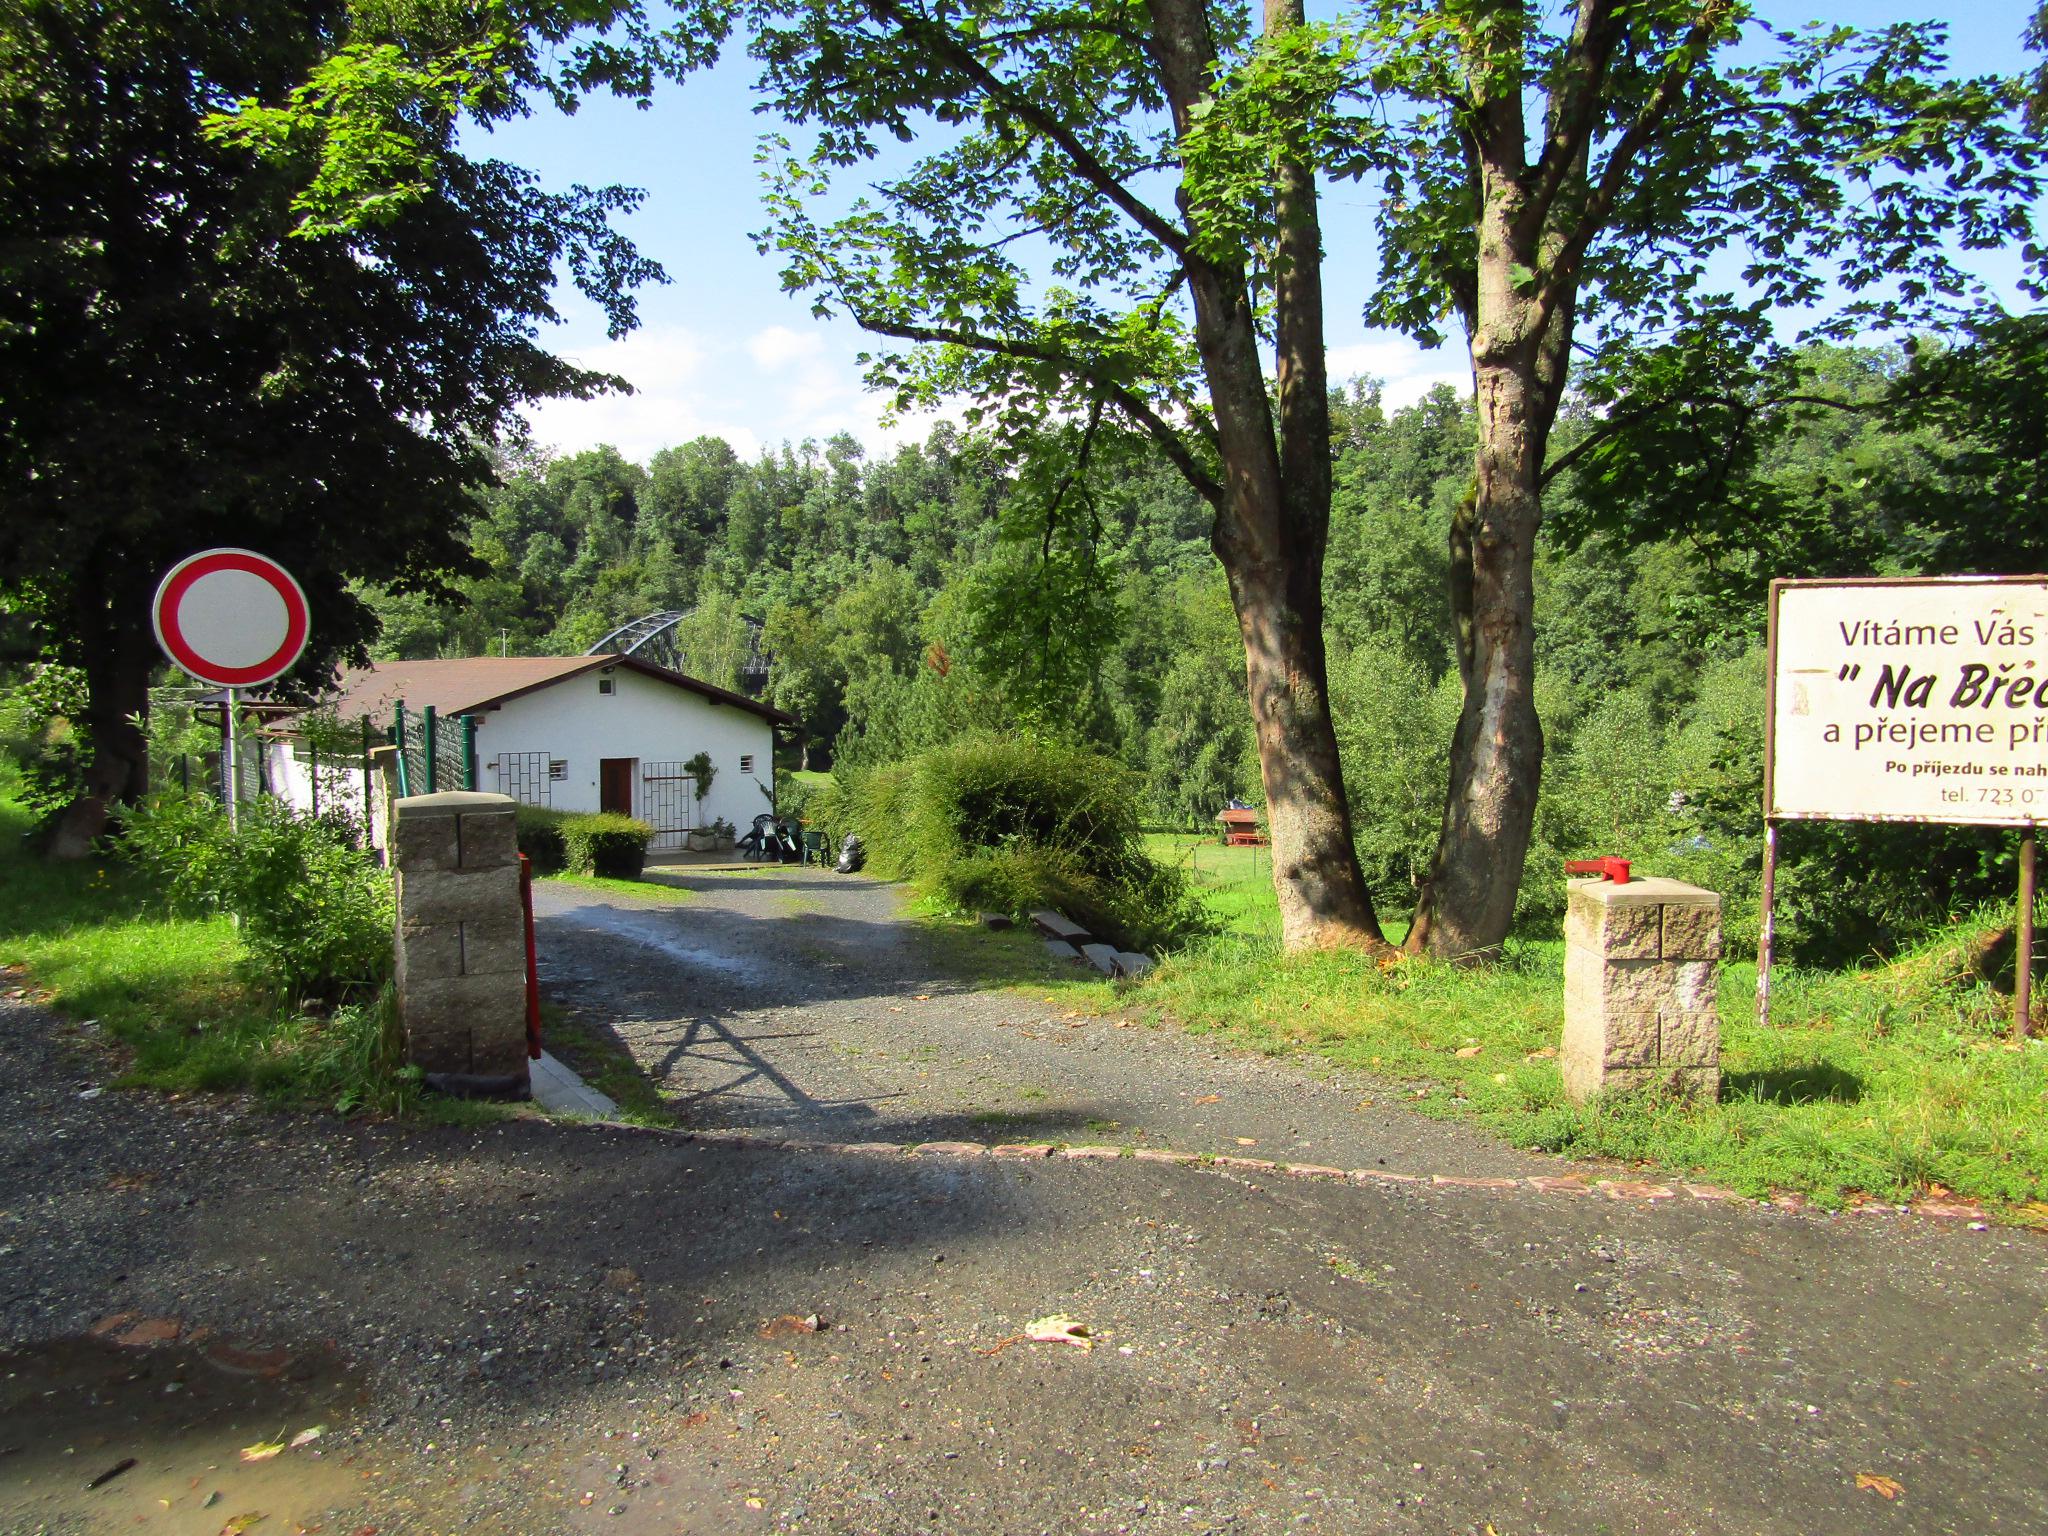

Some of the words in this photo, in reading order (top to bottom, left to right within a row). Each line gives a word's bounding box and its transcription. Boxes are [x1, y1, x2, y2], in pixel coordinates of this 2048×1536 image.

[1838, 619, 1960, 646] Vítáme
[1973, 618, 2035, 646] Vás
[1822, 722, 1841, 743] a
[1854, 716, 1995, 751] přejeme
[2008, 716, 2048, 752] př
[1885, 760, 1907, 773] Po
[1912, 760, 1983, 778] příjezdu
[1988, 765, 2009, 776] se
[1940, 786, 1969, 803] tel.
[1976, 787, 2014, 804] 723
